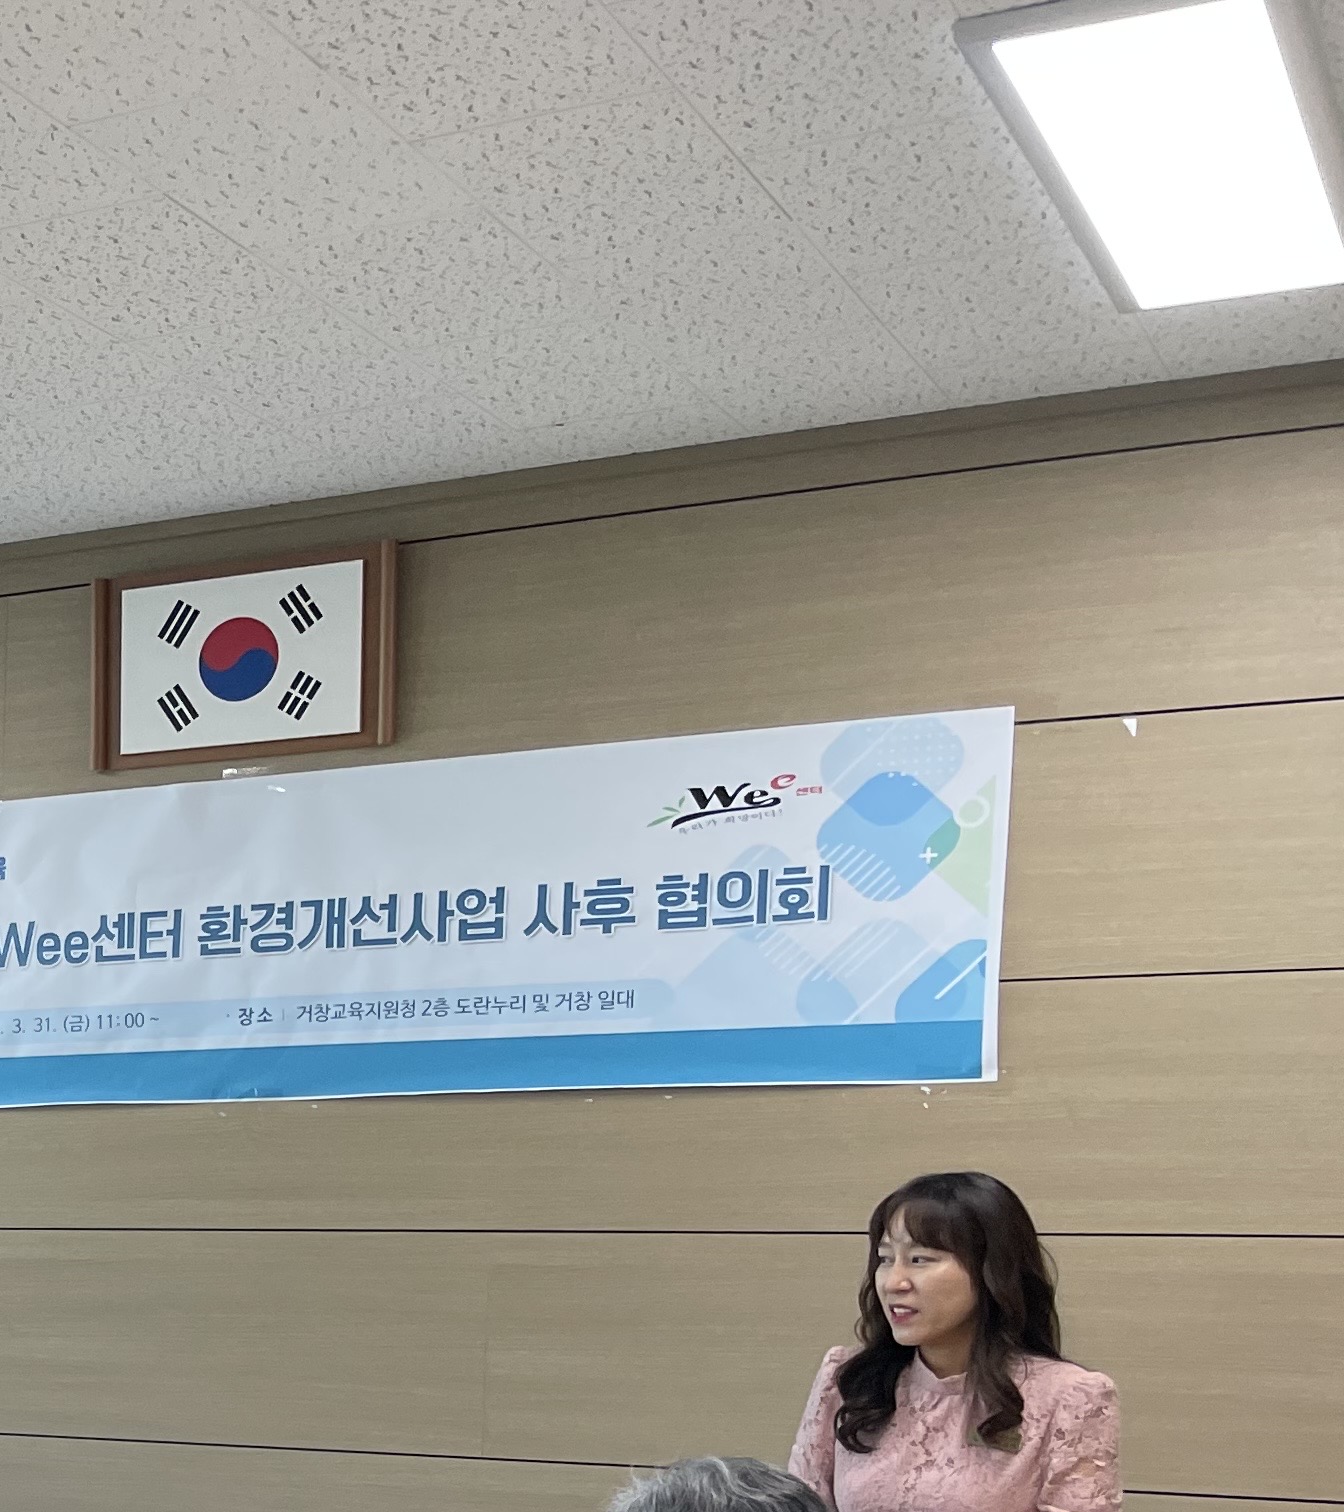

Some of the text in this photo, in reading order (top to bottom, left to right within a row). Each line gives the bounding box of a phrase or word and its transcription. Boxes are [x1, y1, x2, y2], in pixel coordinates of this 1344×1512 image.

[197, 886, 506, 957] 환경개선사업
[523, 877, 636, 937] 사후
[655, 864, 831, 931] 협의회
[11, 1018, 26, 1035] 3.
[32, 1016, 57, 1034] 31.
[63, 1014, 90, 1034] (금)
[96, 1012, 145, 1031] 11:00
[237, 988, 635, 1027] 장소 거창교육지원청 2층 도란누리 및 거창 일대
